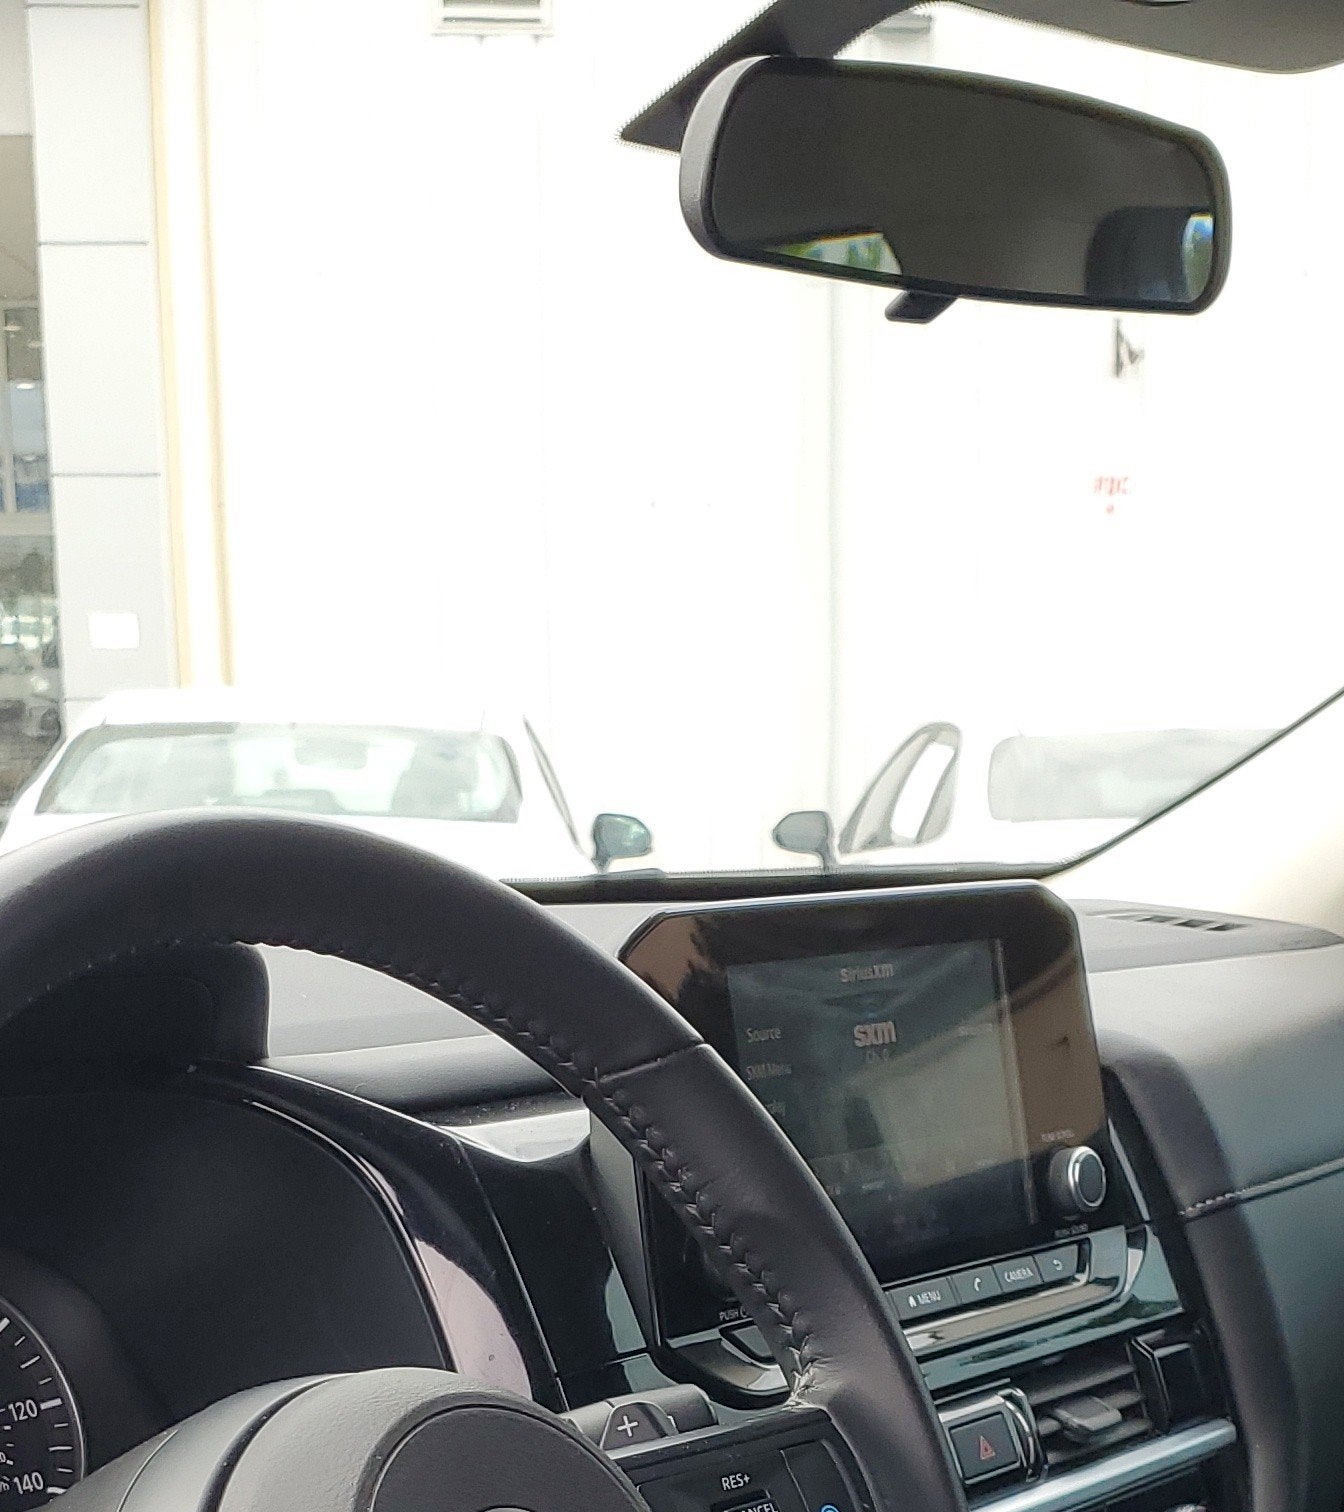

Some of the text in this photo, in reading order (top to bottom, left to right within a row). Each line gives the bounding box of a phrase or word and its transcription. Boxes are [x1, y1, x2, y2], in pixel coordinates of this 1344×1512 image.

[917, 1290, 941, 1306] MENU
[8, 1399, 38, 1422] 120
[13, 1471, 44, 1495] 140
[721, 1472, 751, 1491] RES+
